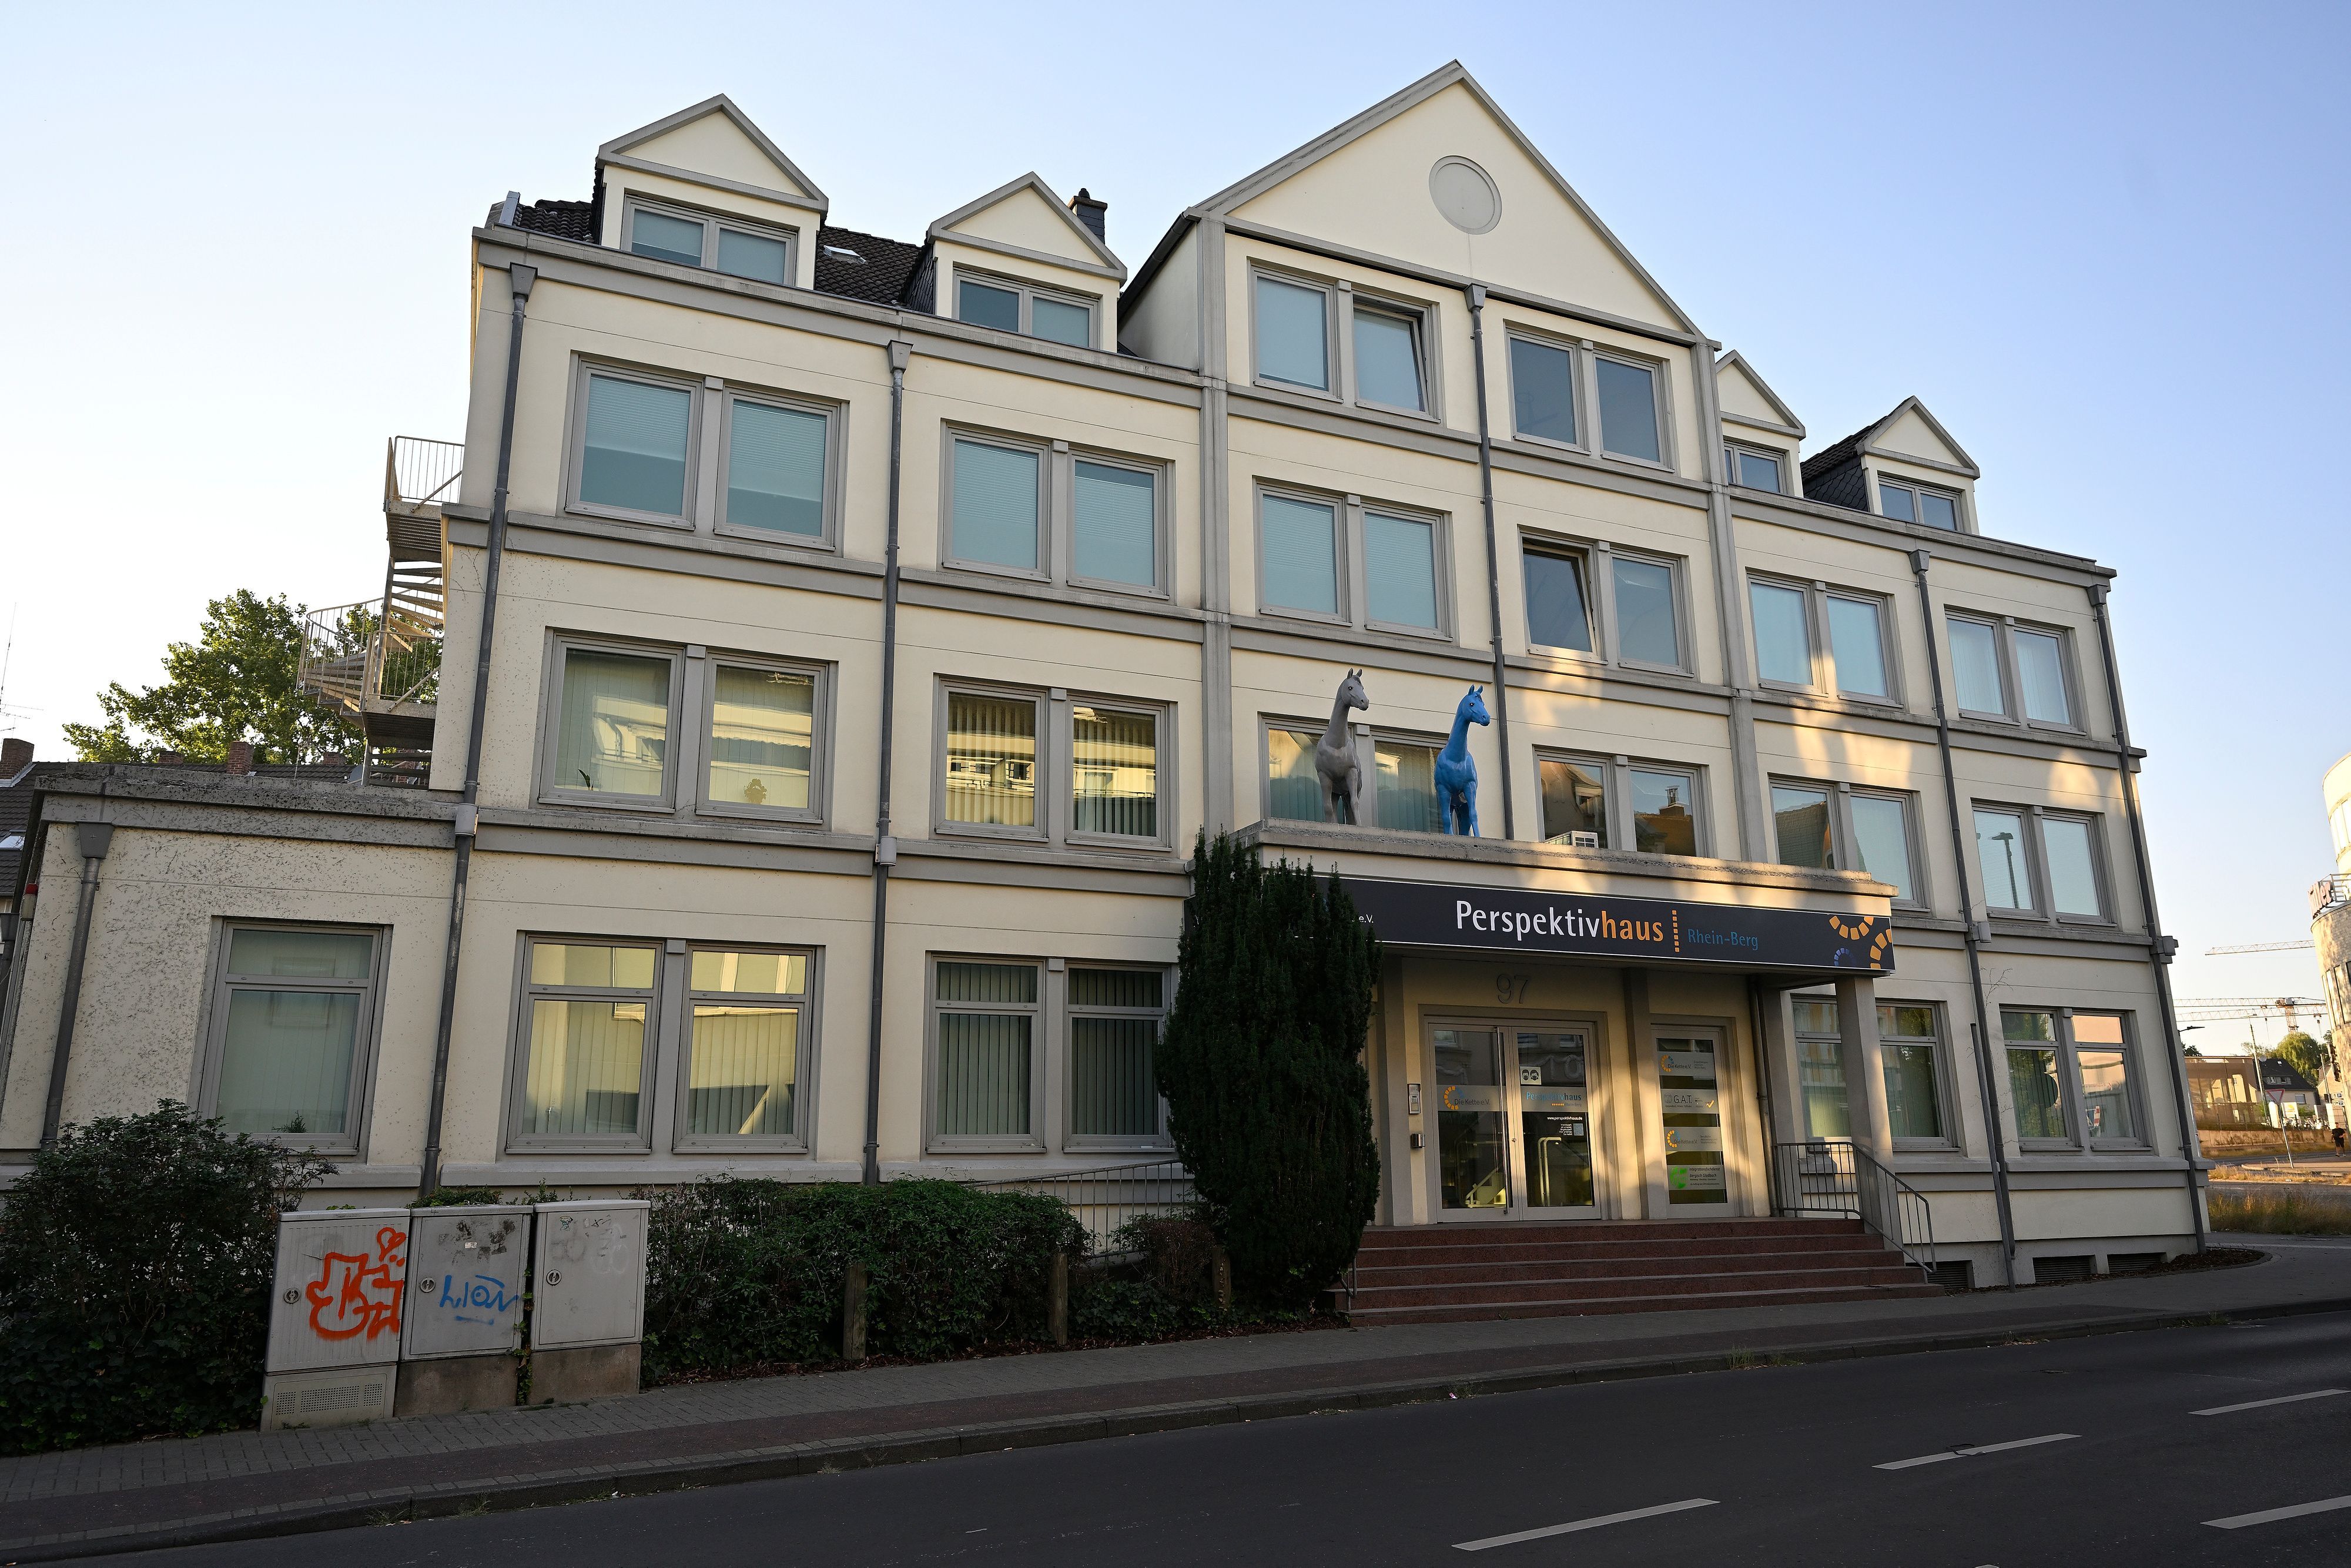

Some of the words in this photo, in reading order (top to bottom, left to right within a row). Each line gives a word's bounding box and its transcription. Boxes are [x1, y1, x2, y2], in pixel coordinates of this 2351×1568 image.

[1358, 914, 1374, 923] e.V.
[1456, 900, 1664, 942] Perspektivhaus
[1687, 929, 1759, 950] Rhein-Berg
[1496, 973, 1529, 1004] 97
[1526, 1092, 1582, 1101] Perspektivhaus
[1673, 1095, 1692, 1104] G.A.T.
